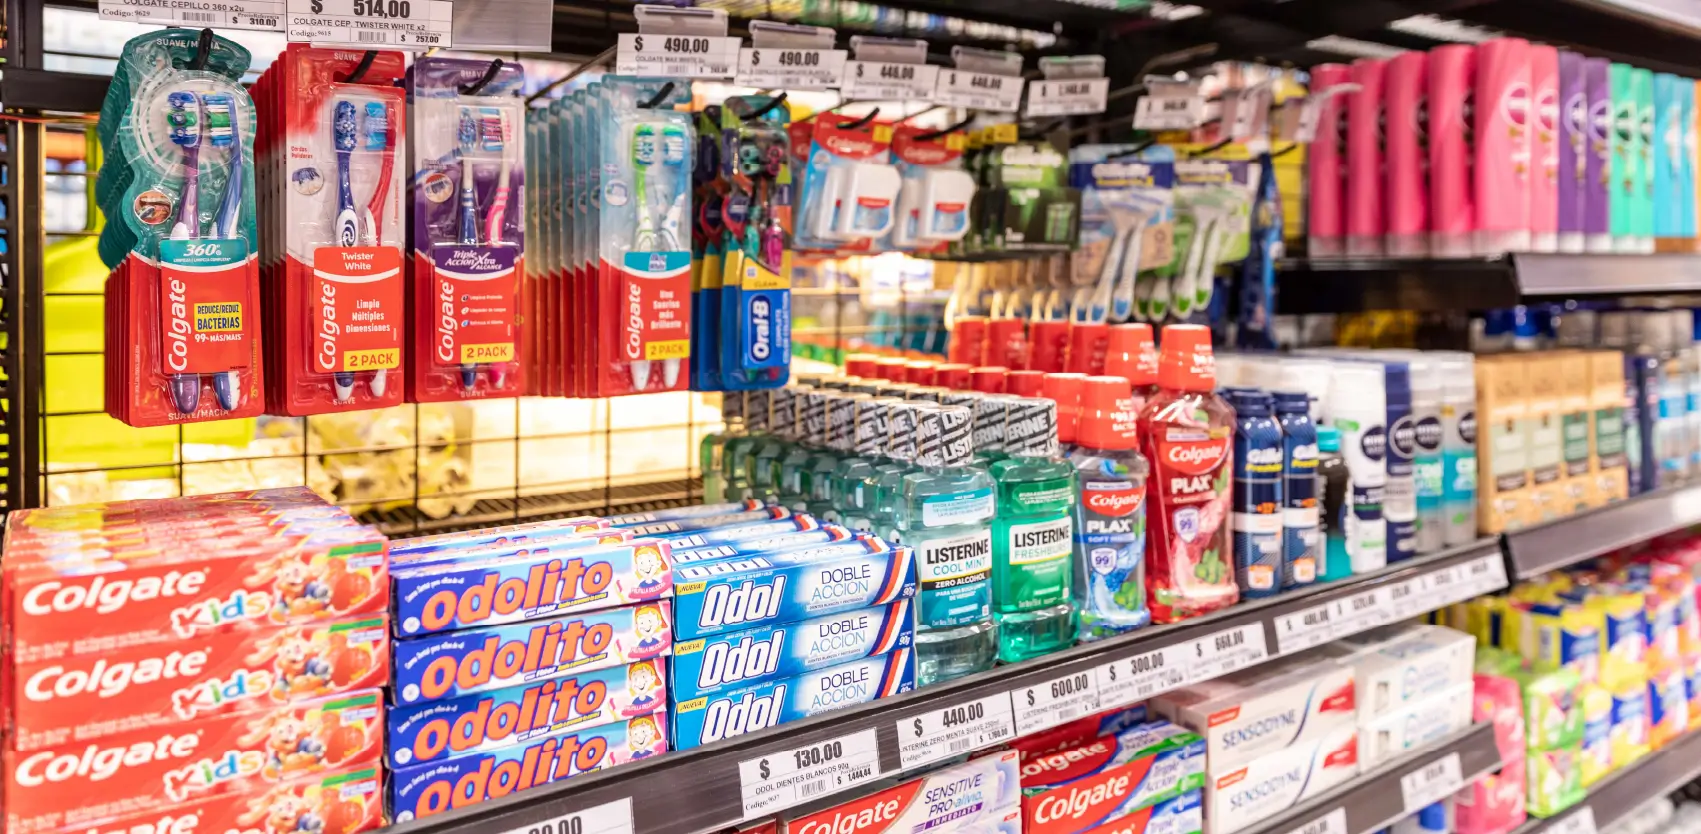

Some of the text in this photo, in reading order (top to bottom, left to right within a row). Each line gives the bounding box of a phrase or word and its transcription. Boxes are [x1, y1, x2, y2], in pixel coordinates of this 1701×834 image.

[171, 0, 210, 10] CEPILLO
[212, 3, 226, 11] 360
[311, 0, 410, 19] $ 514,00
[294, 18, 333, 26] COLGATE
[334, 20, 353, 28] CEP.
[355, 21, 390, 30] TWISTER
[390, 22, 415, 31] WHITE
[634, 36, 709, 54] $ 490,00
[334, 52, 358, 62] SUAVE
[752, 50, 820, 66] $ 490,00
[856, 64, 864, 78] $
[949, 73, 956, 86] $
[342, 252, 374, 260] Twister
[344, 262, 372, 270] White
[453, 250, 477, 259] Triple
[197, 304, 240, 314] REDUCE/REDUZ
[356, 299, 380, 309] Limpio
[168, 279, 191, 372] Colgate
[320, 283, 340, 370] Colgate
[346, 324, 390, 334] Dimensiones
[439, 281, 458, 362] Colgate
[626, 284, 644, 358] Colgate
[752, 300, 770, 358] Oral-B
[350, 353, 394, 366] 2 PACK
[466, 346, 508, 358] 2 PACK
[651, 344, 684, 355] 2 PACK
[1168, 446, 1222, 465] Colgate
[1171, 476, 1212, 494] PLAX
[1090, 493, 1141, 509] Colgate
[1014, 525, 1070, 548] LISTERINE
[1086, 519, 1132, 533] PLAX
[926, 538, 989, 564] LISTERINE
[822, 564, 871, 584] DOBLE
[933, 556, 986, 576] COOL MINT
[936, 573, 986, 588] ZERO ALCOHOL
[22, 569, 206, 616] Colgate
[420, 558, 613, 630] odolito
[699, 575, 787, 628] Odol
[171, 590, 272, 638] Kids
[820, 616, 868, 638] DOBLE
[420, 620, 613, 699] odolito
[698, 630, 786, 689] Odol
[1196, 644, 1202, 657] $
[25, 651, 208, 702] Colgate
[821, 666, 870, 691] DOBLE
[1110, 652, 1164, 682] $ 300,00
[172, 669, 272, 720] Kids
[1028, 674, 1088, 706] $ 600,00
[413, 680, 606, 760] odolito
[700, 684, 788, 746] Odol
[914, 702, 984, 738] $ 440,00
[930, 735, 945, 744] ZERO
[946, 730, 966, 740] MENTA
[966, 724, 984, 734] SUAVE
[980, 735, 984, 744] $
[1222, 708, 1296, 750] SENSODYNE
[15, 734, 199, 786] Colgate
[760, 758, 770, 780] $
[794, 740, 843, 770] 130,00
[163, 750, 264, 802] Kids
[416, 735, 608, 819] odolito
[755, 784, 774, 795] ODOL
[776, 774, 804, 788] DIENTES
[806, 766, 836, 780] BLANCOS
[837, 776, 842, 785] $
[848, 768, 872, 782] 1.444,44
[924, 774, 982, 805] SENSITIVE
[1034, 772, 1130, 824] Colgate
[1230, 768, 1302, 812] SENSODYNE
[800, 797, 900, 834] Colgate
[931, 804, 978, 827] INMEDIATO
